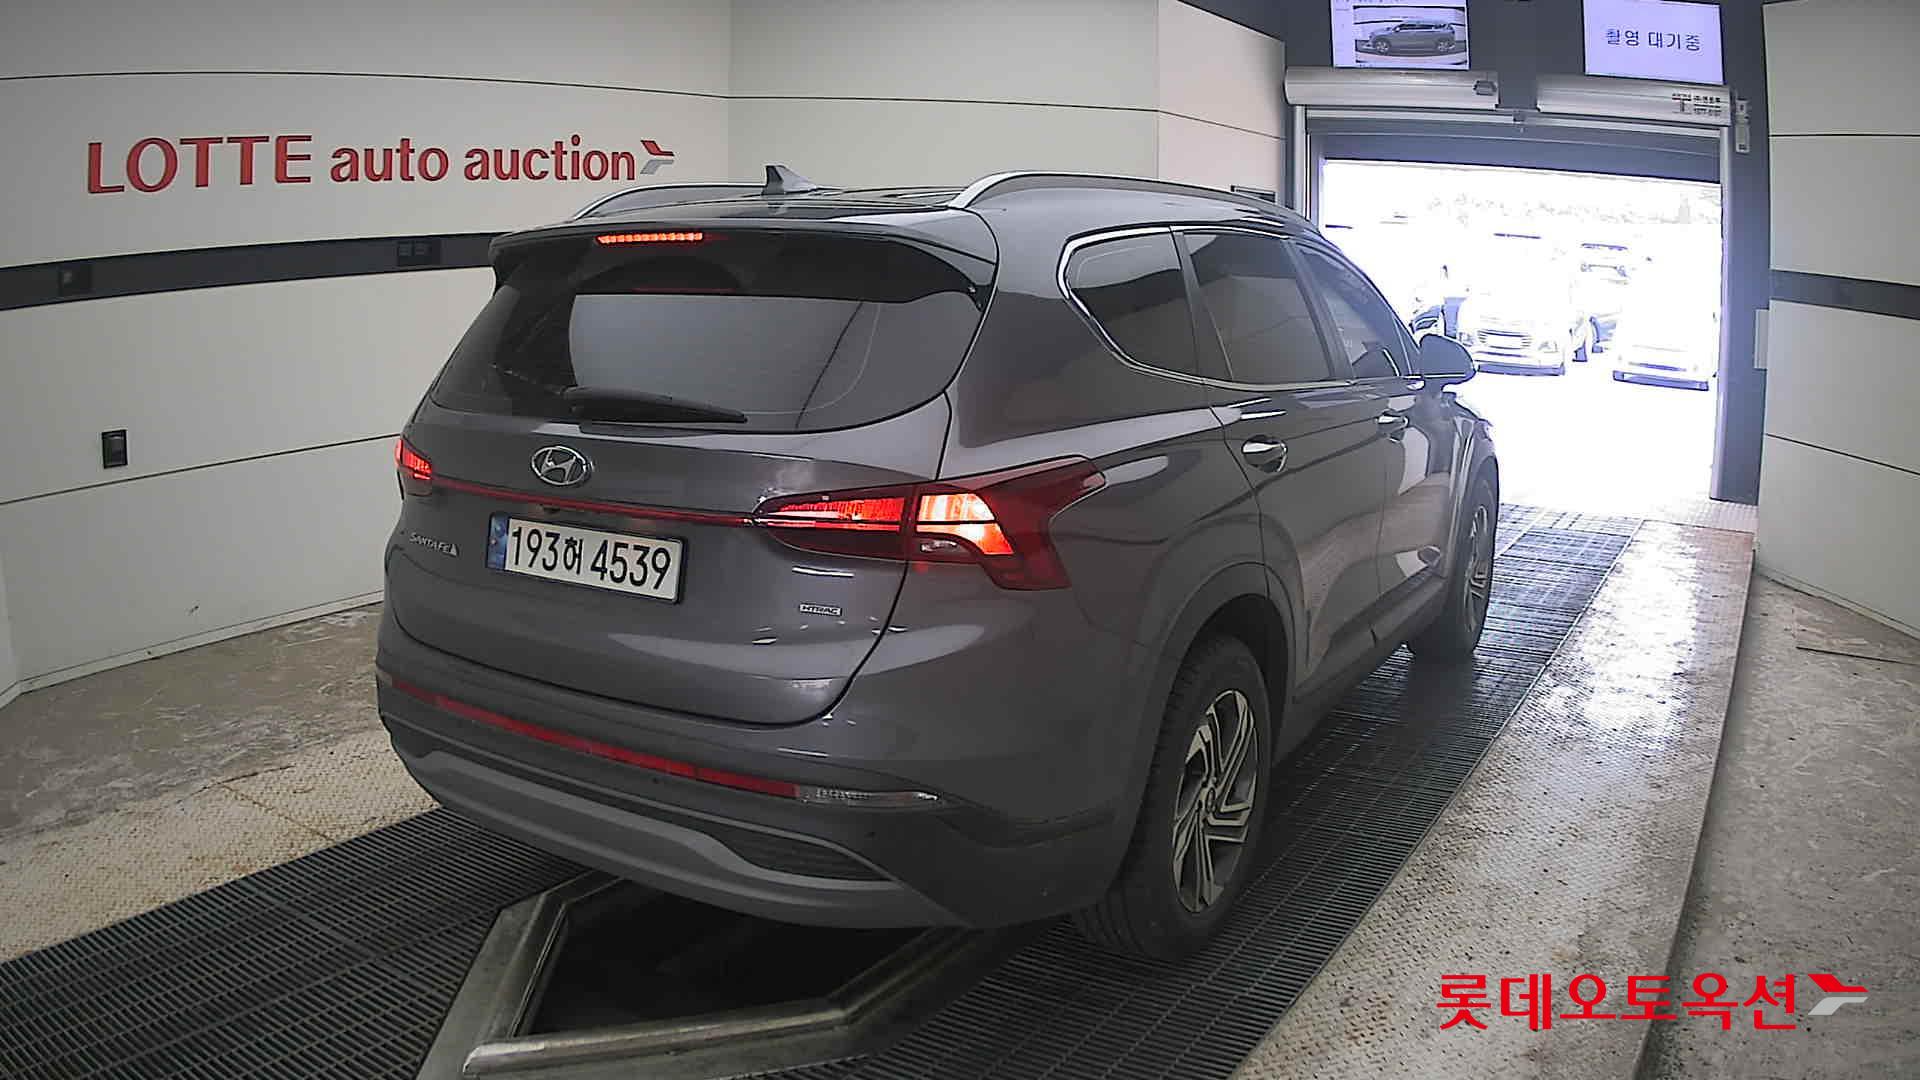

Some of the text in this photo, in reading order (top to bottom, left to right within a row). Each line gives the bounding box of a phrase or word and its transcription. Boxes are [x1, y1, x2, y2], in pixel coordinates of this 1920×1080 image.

[1648, 31, 1700, 51] 대기중
[87, 134, 635, 194] LOTTE auto auction
[511, 526, 672, 590] 193허 4539
